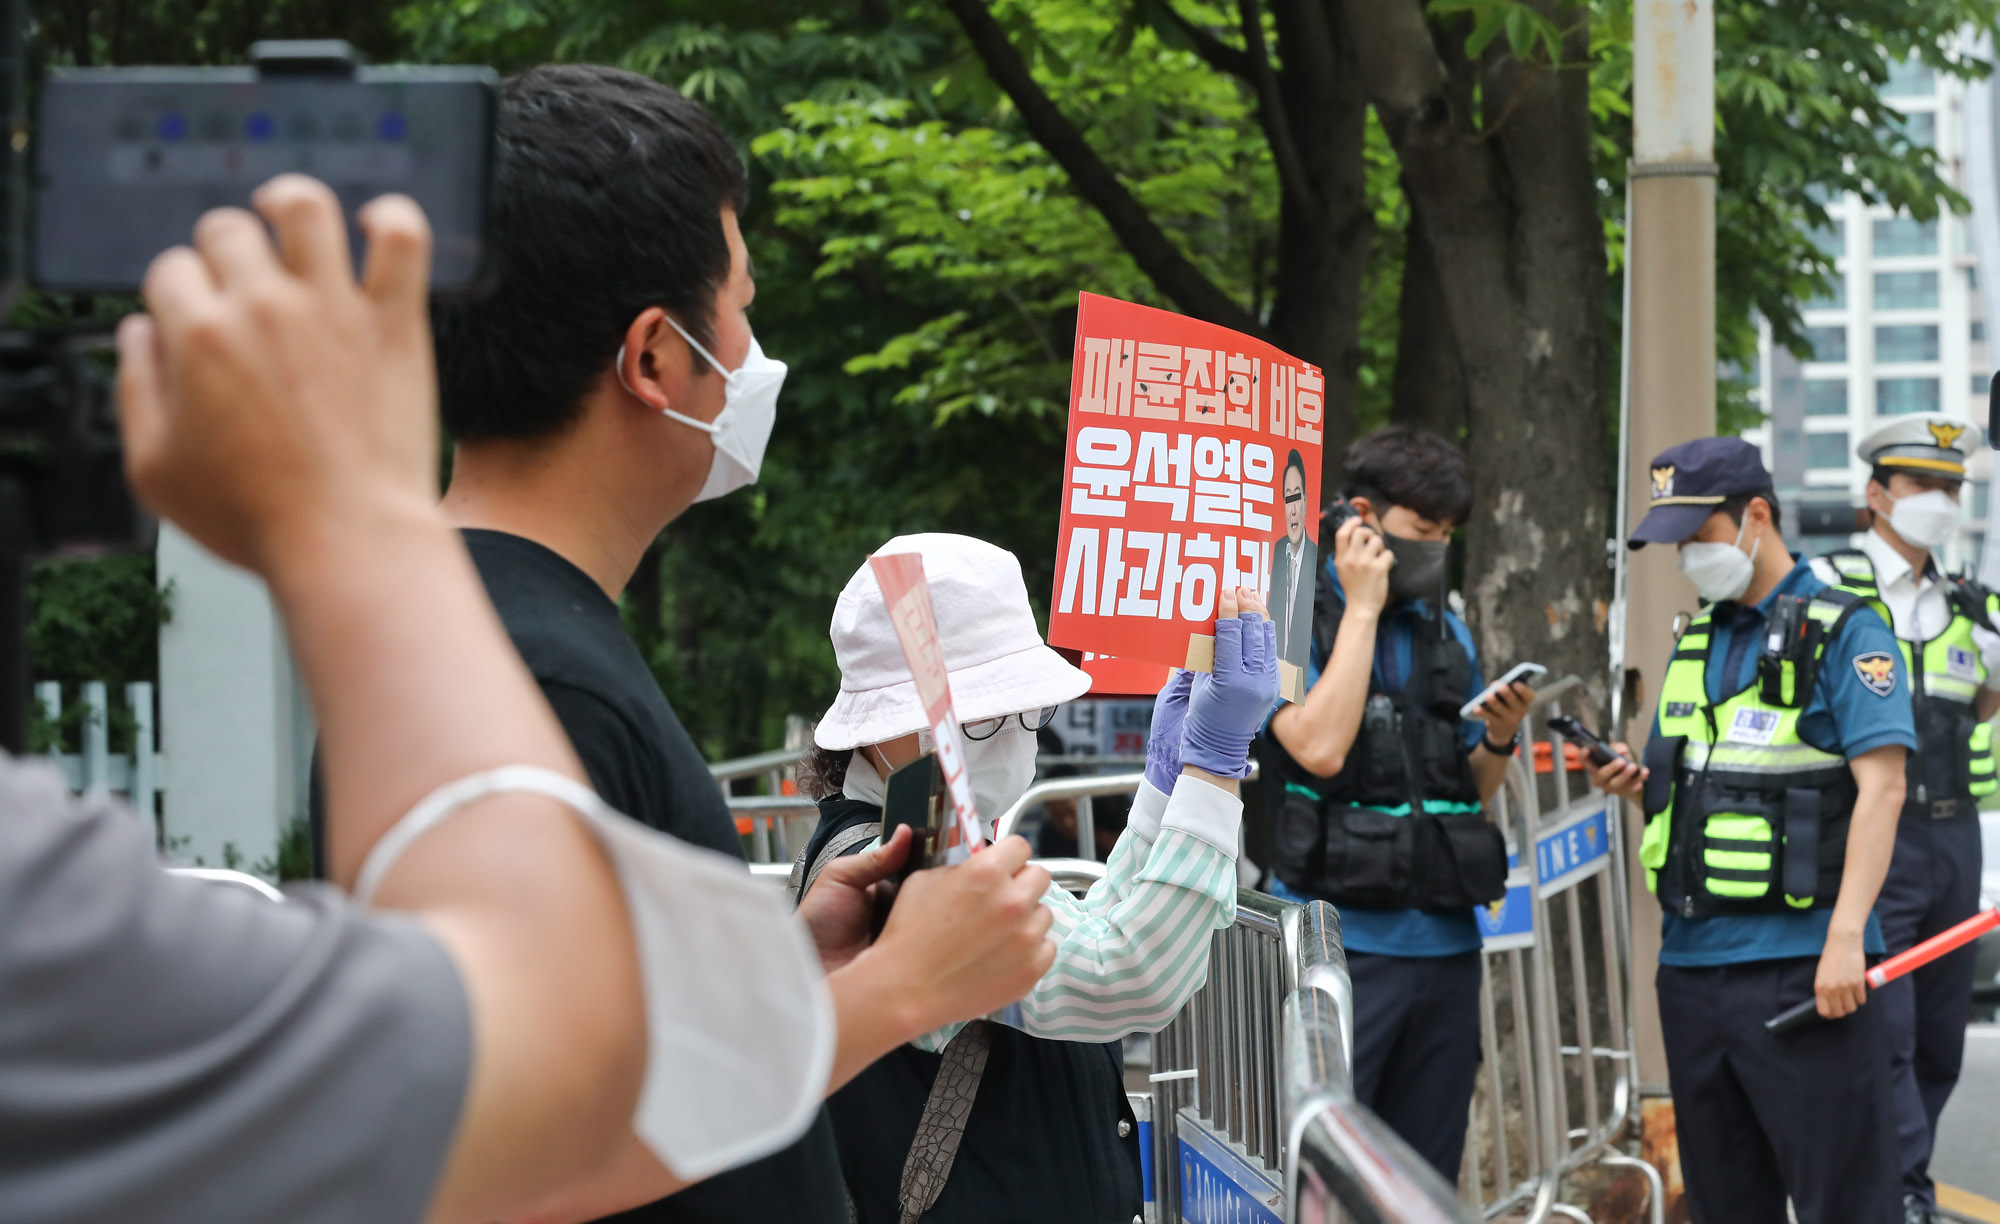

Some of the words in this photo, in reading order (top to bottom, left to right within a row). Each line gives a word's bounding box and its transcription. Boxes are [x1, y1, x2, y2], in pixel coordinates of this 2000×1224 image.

[1078, 337, 1261, 432] 패륜집회
[1269, 362, 1322, 445] 비호
[1070, 426, 1275, 532] 윤석열은
[1058, 527, 1271, 622] 사과하라
